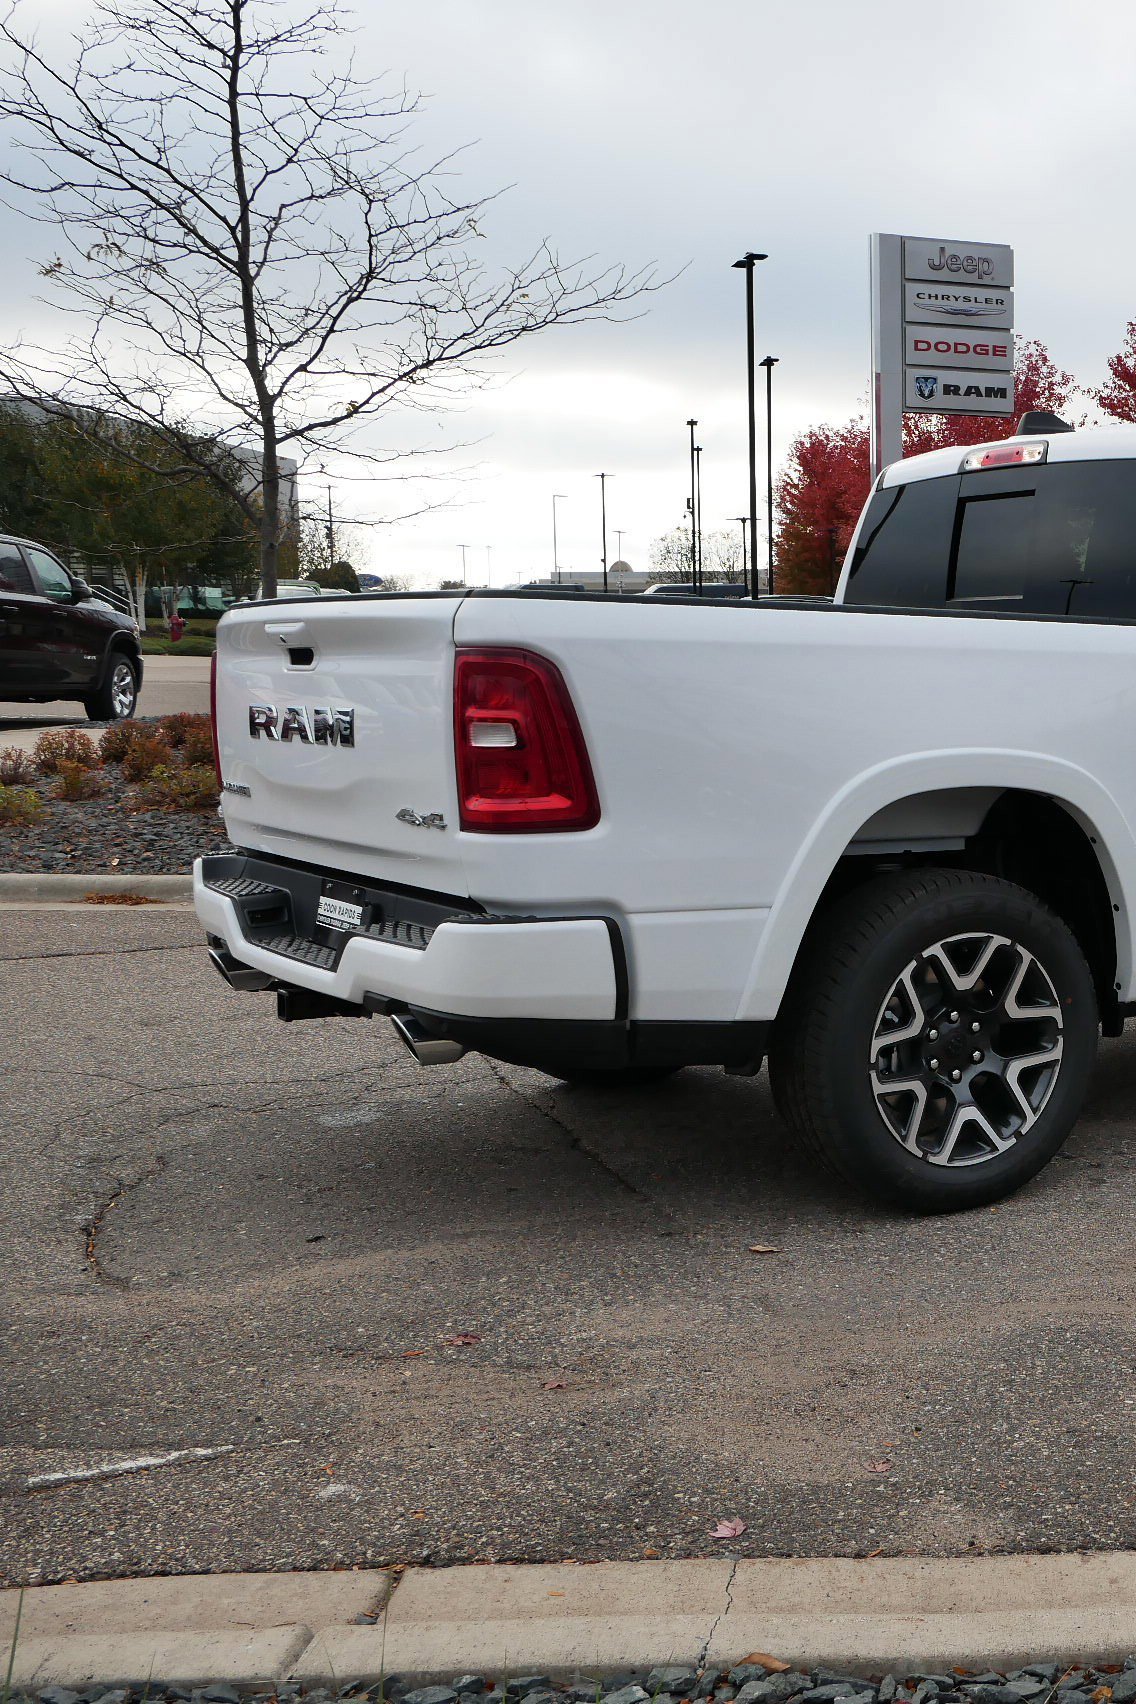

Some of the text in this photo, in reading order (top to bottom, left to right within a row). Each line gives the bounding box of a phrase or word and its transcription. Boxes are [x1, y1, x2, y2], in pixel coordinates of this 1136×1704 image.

[927, 246, 994, 280] Jeep
[916, 292, 1005, 306] CHRYSLER
[913, 339, 1007, 358] DODGE
[942, 383, 1007, 399] RAM
[249, 703, 355, 748] RAM
